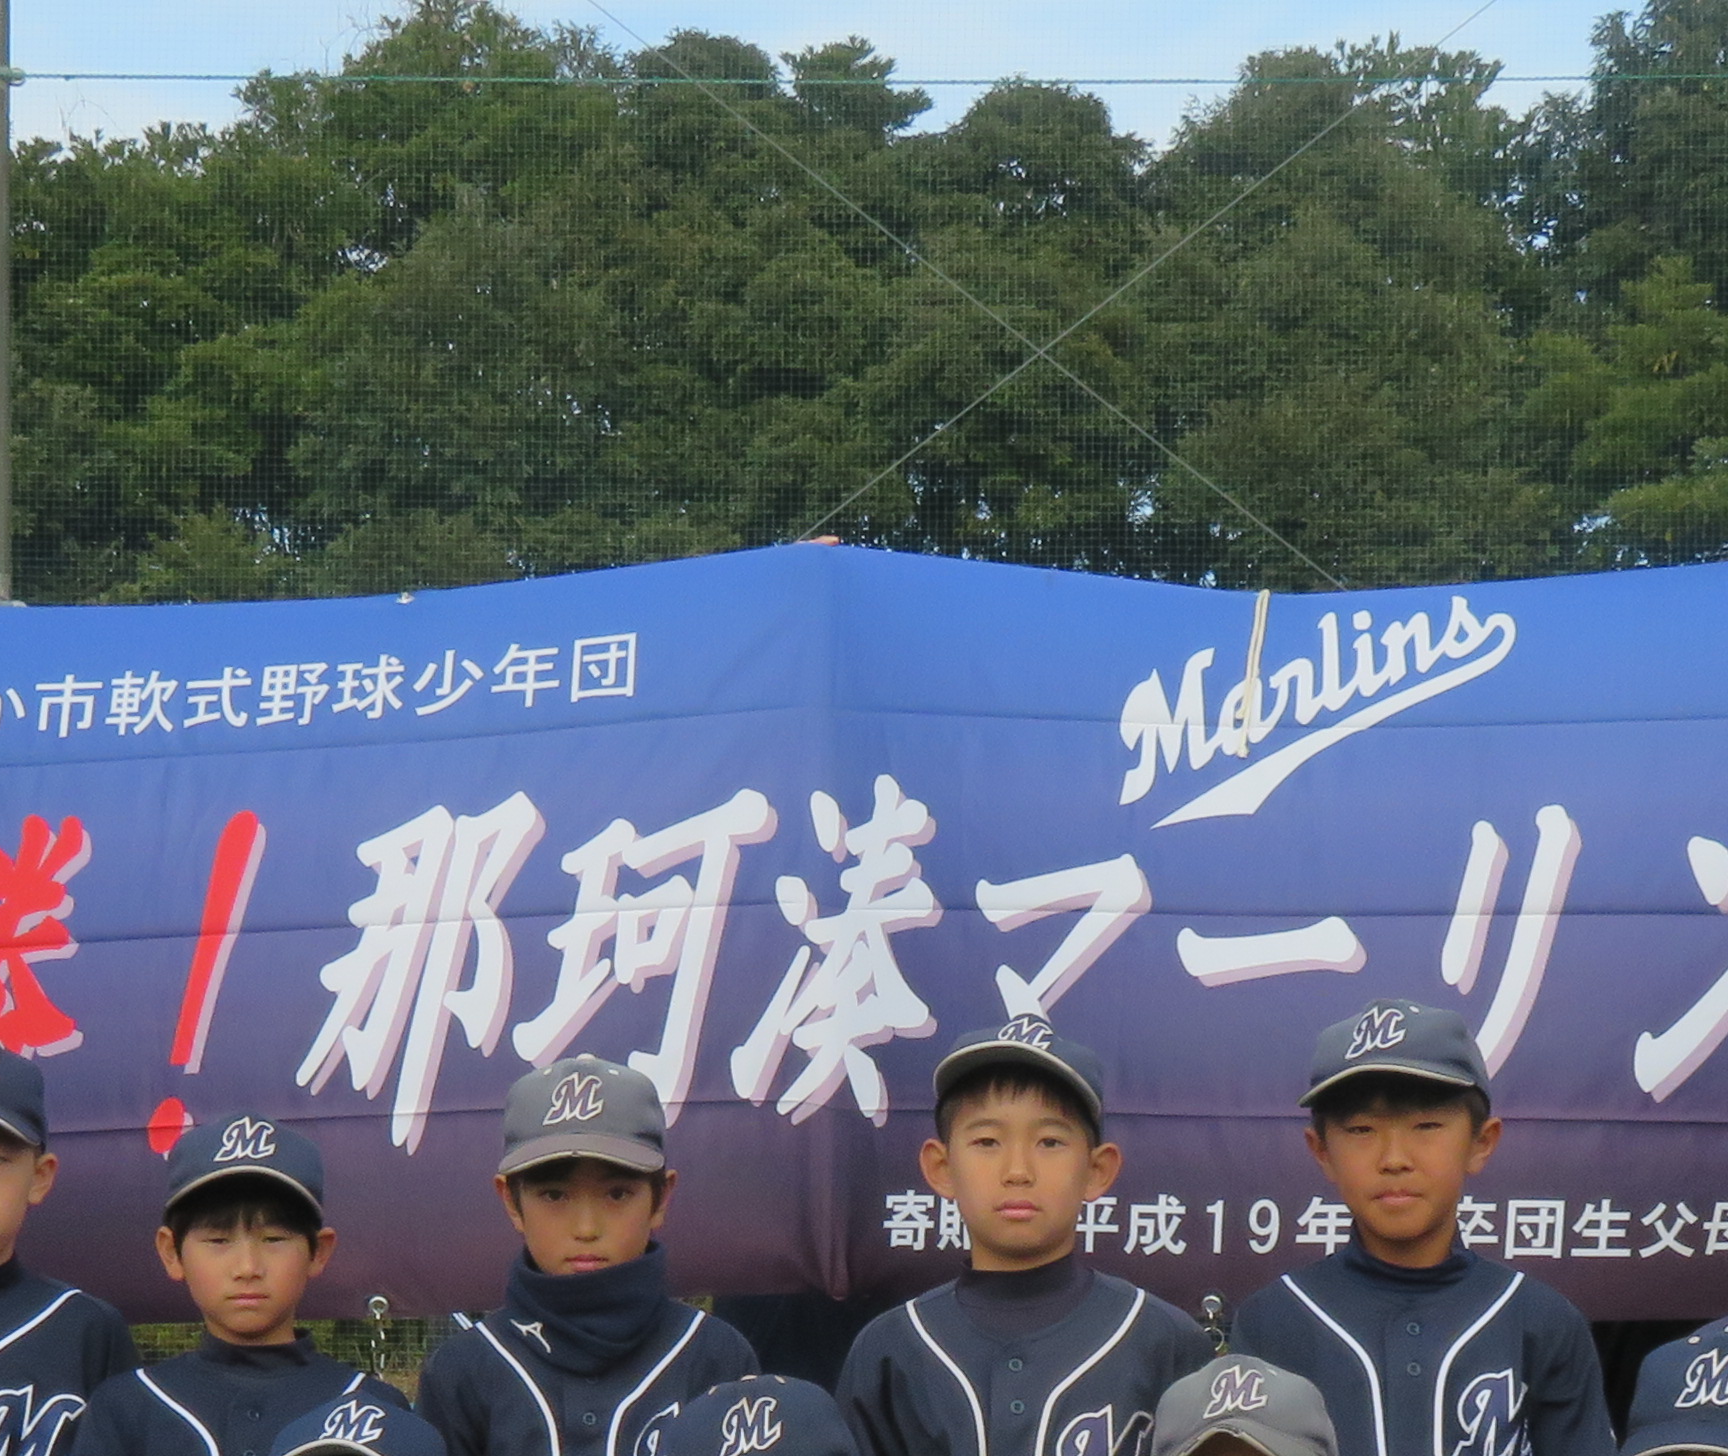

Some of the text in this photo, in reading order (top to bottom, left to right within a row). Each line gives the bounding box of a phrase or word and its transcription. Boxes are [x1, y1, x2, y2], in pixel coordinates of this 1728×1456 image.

[1119, 595, 1517, 805] Marlins
[1344, 1006, 1406, 1061] M
[542, 1072, 604, 1126] M
[213, 1117, 276, 1162] M
[1203, 1365, 1268, 1420] M
[319, 1400, 386, 1445] M
